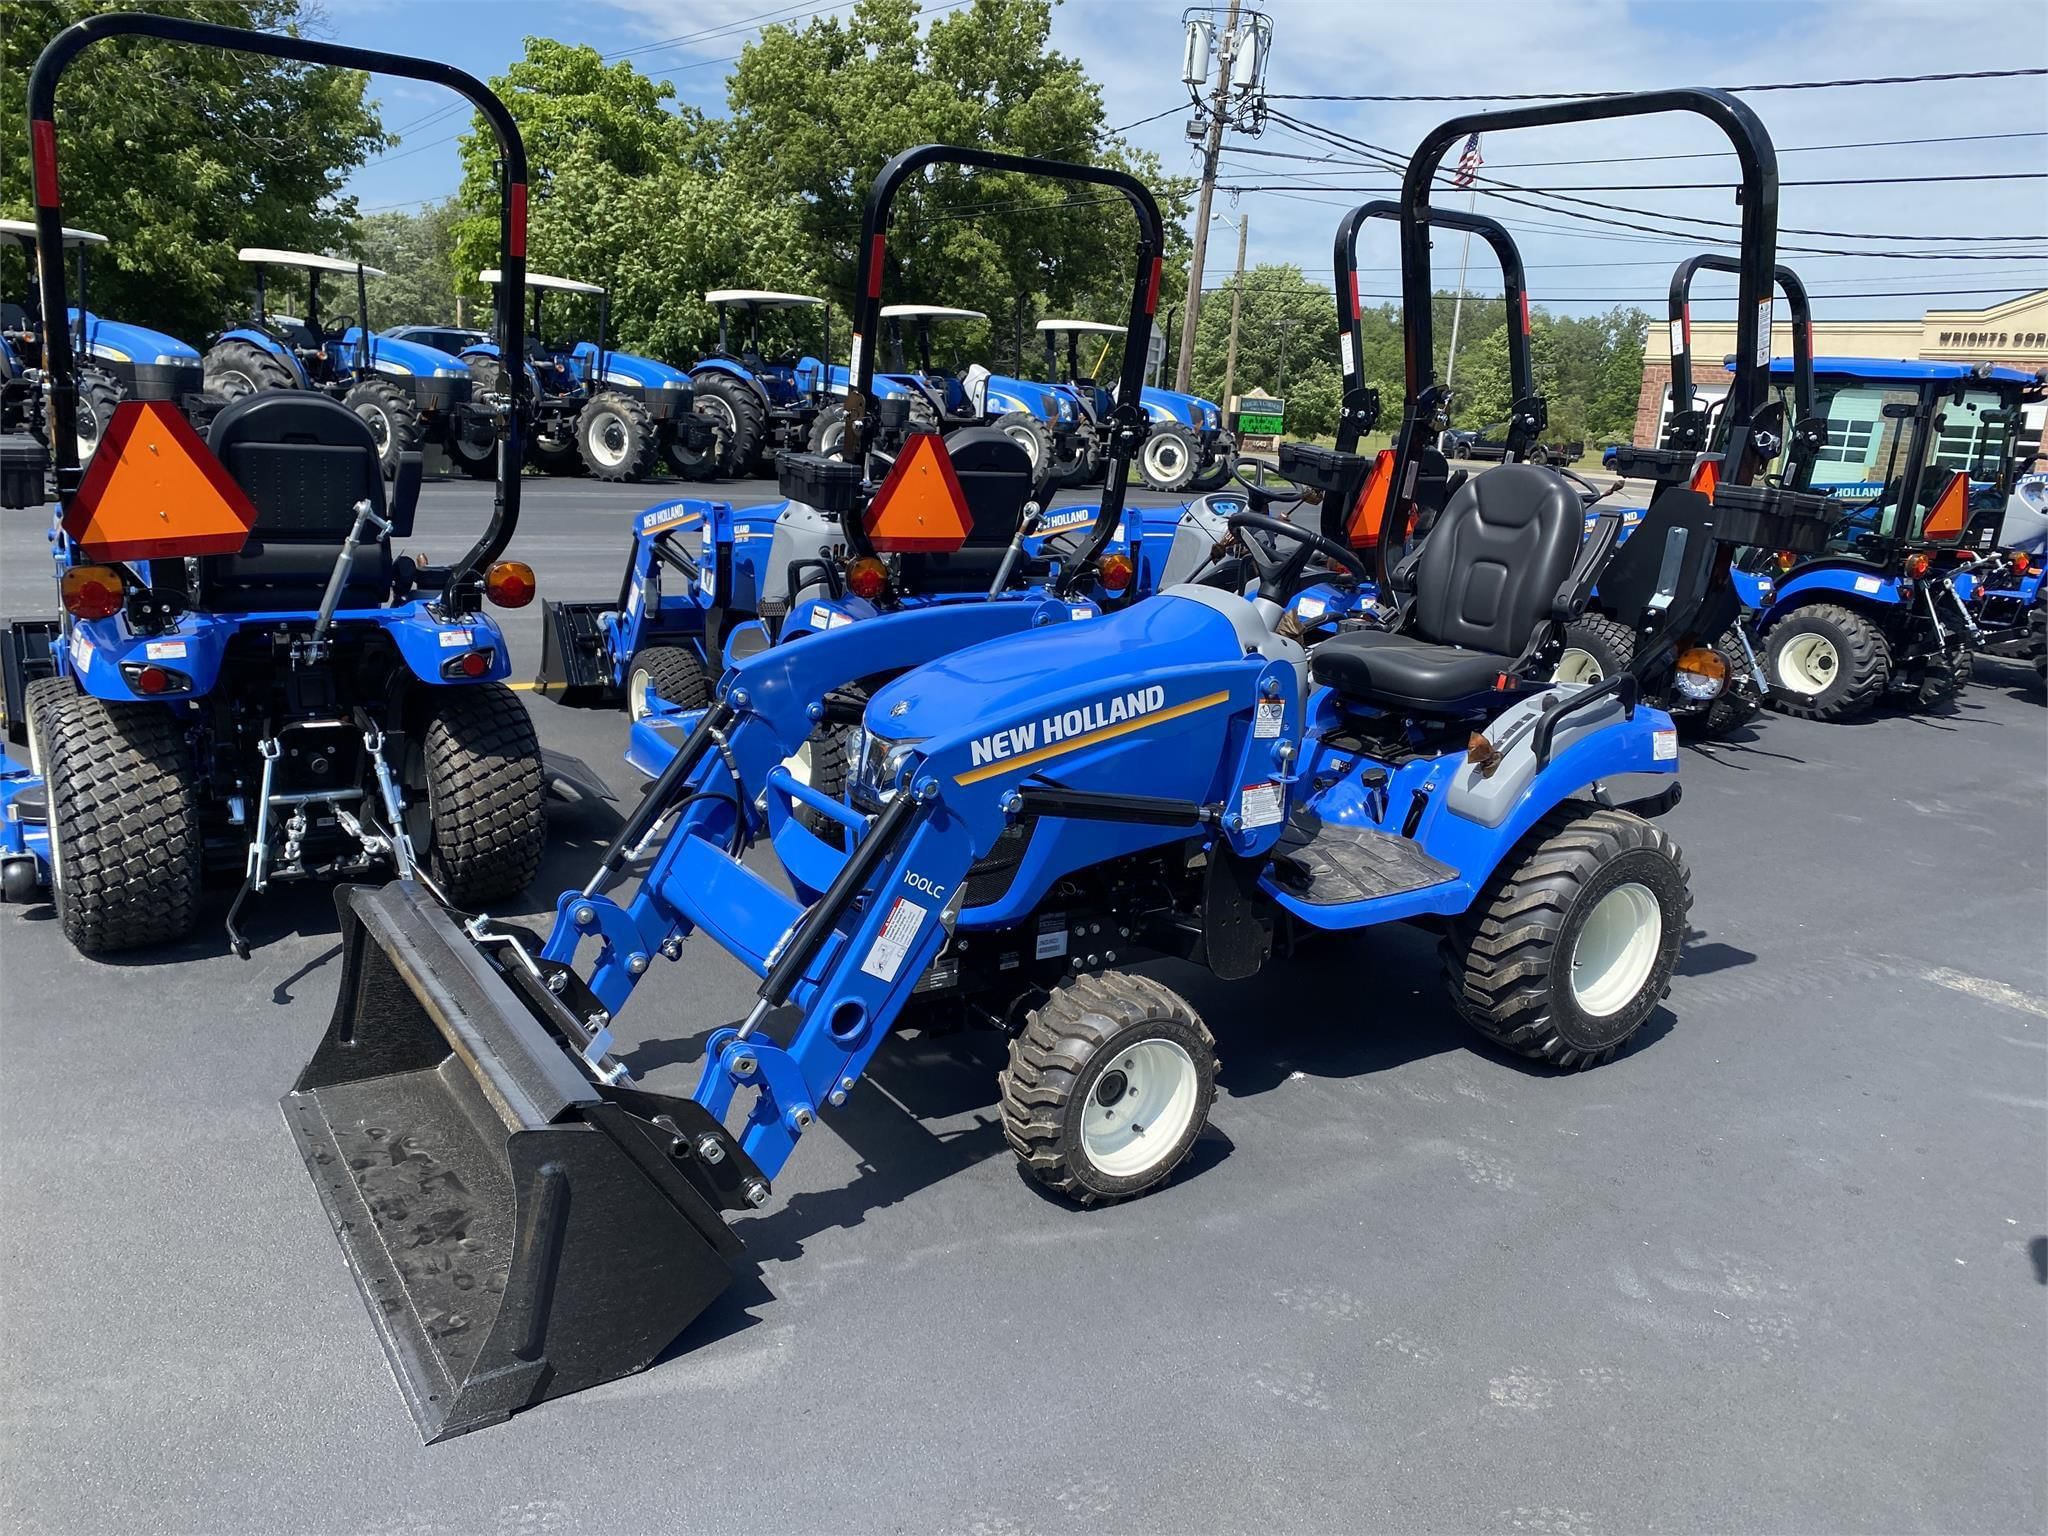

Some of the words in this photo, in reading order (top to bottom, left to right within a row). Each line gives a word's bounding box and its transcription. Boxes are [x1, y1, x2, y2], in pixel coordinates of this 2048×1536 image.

[2013, 332, 2048, 347] COR
[657, 504, 684, 525] HOLLAND
[1051, 509, 1088, 527] HOLLAND
[970, 722, 1036, 767] NEW
[1042, 685, 1165, 745] HOLLAND
[903, 869, 945, 899] 100LC
